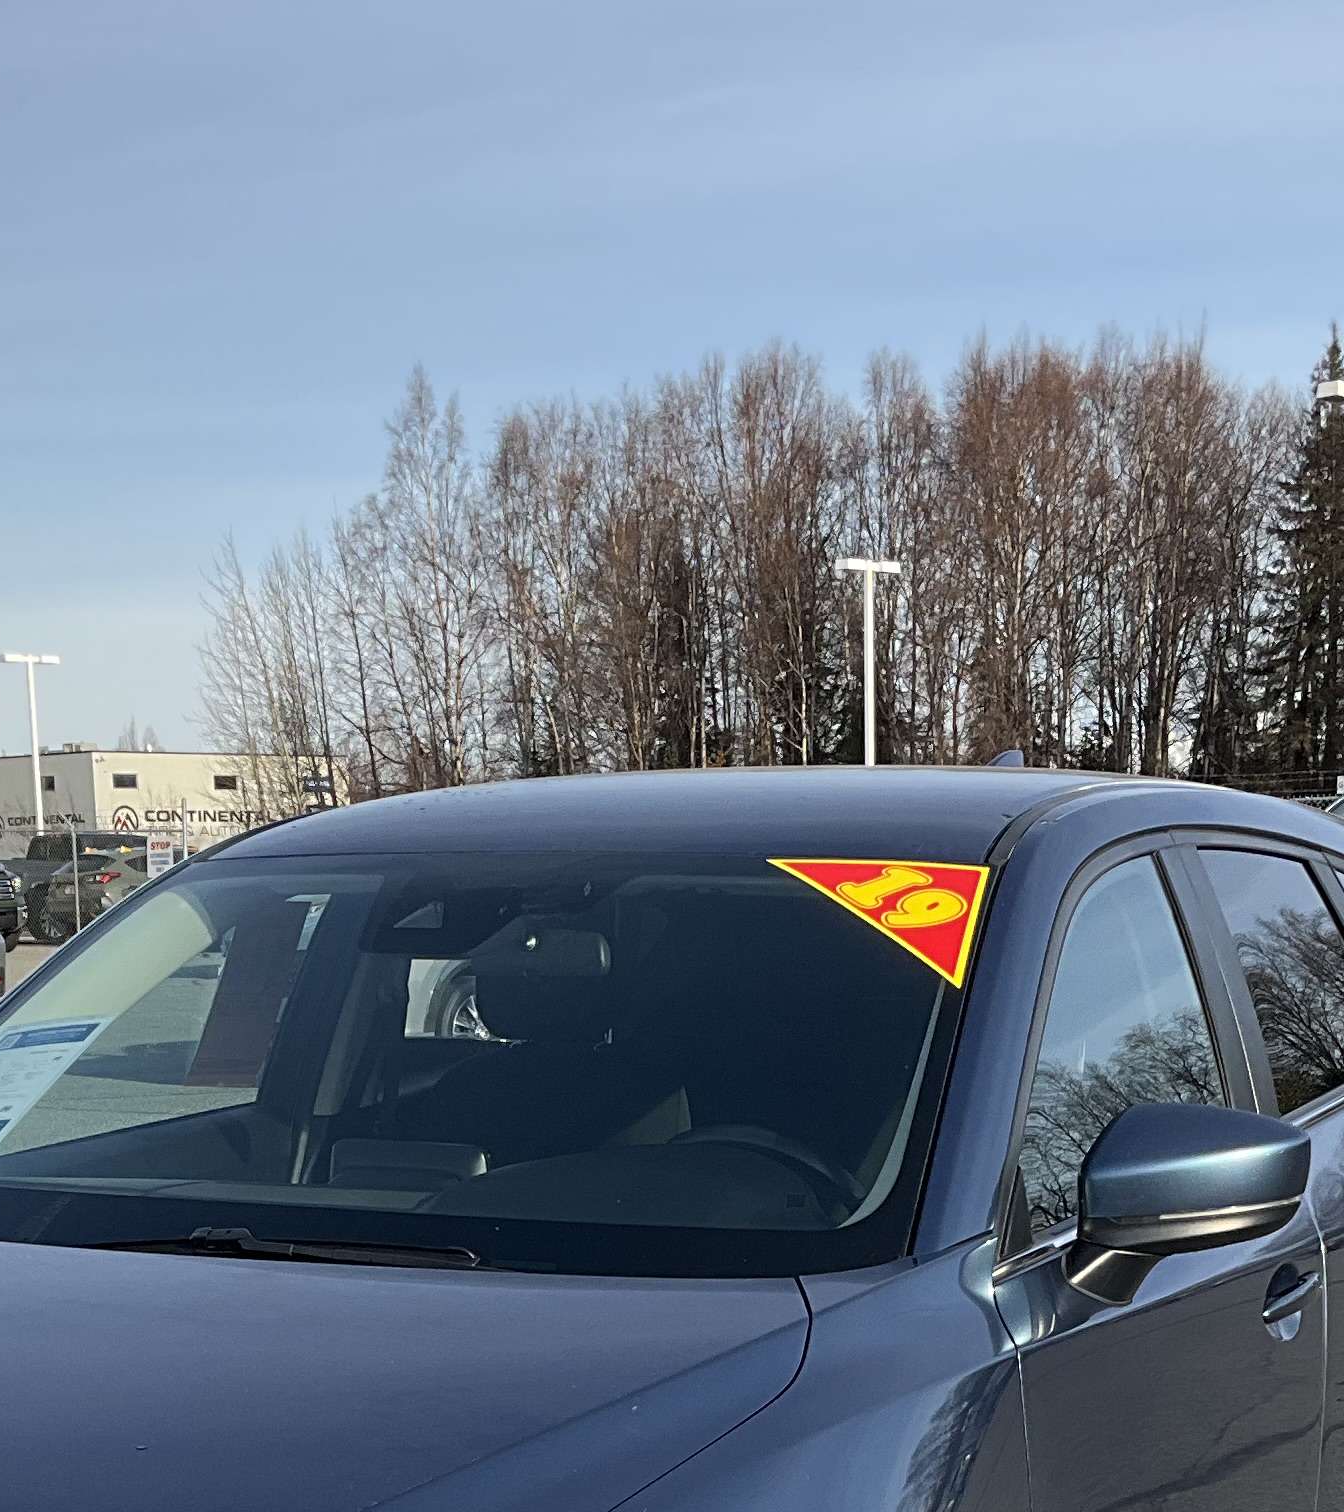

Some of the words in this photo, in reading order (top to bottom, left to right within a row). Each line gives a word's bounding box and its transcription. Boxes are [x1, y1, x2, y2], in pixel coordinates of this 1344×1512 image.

[7, 813, 86, 827] CONTNENTAL
[150, 841, 171, 850] STOP
[836, 866, 968, 928] 19
